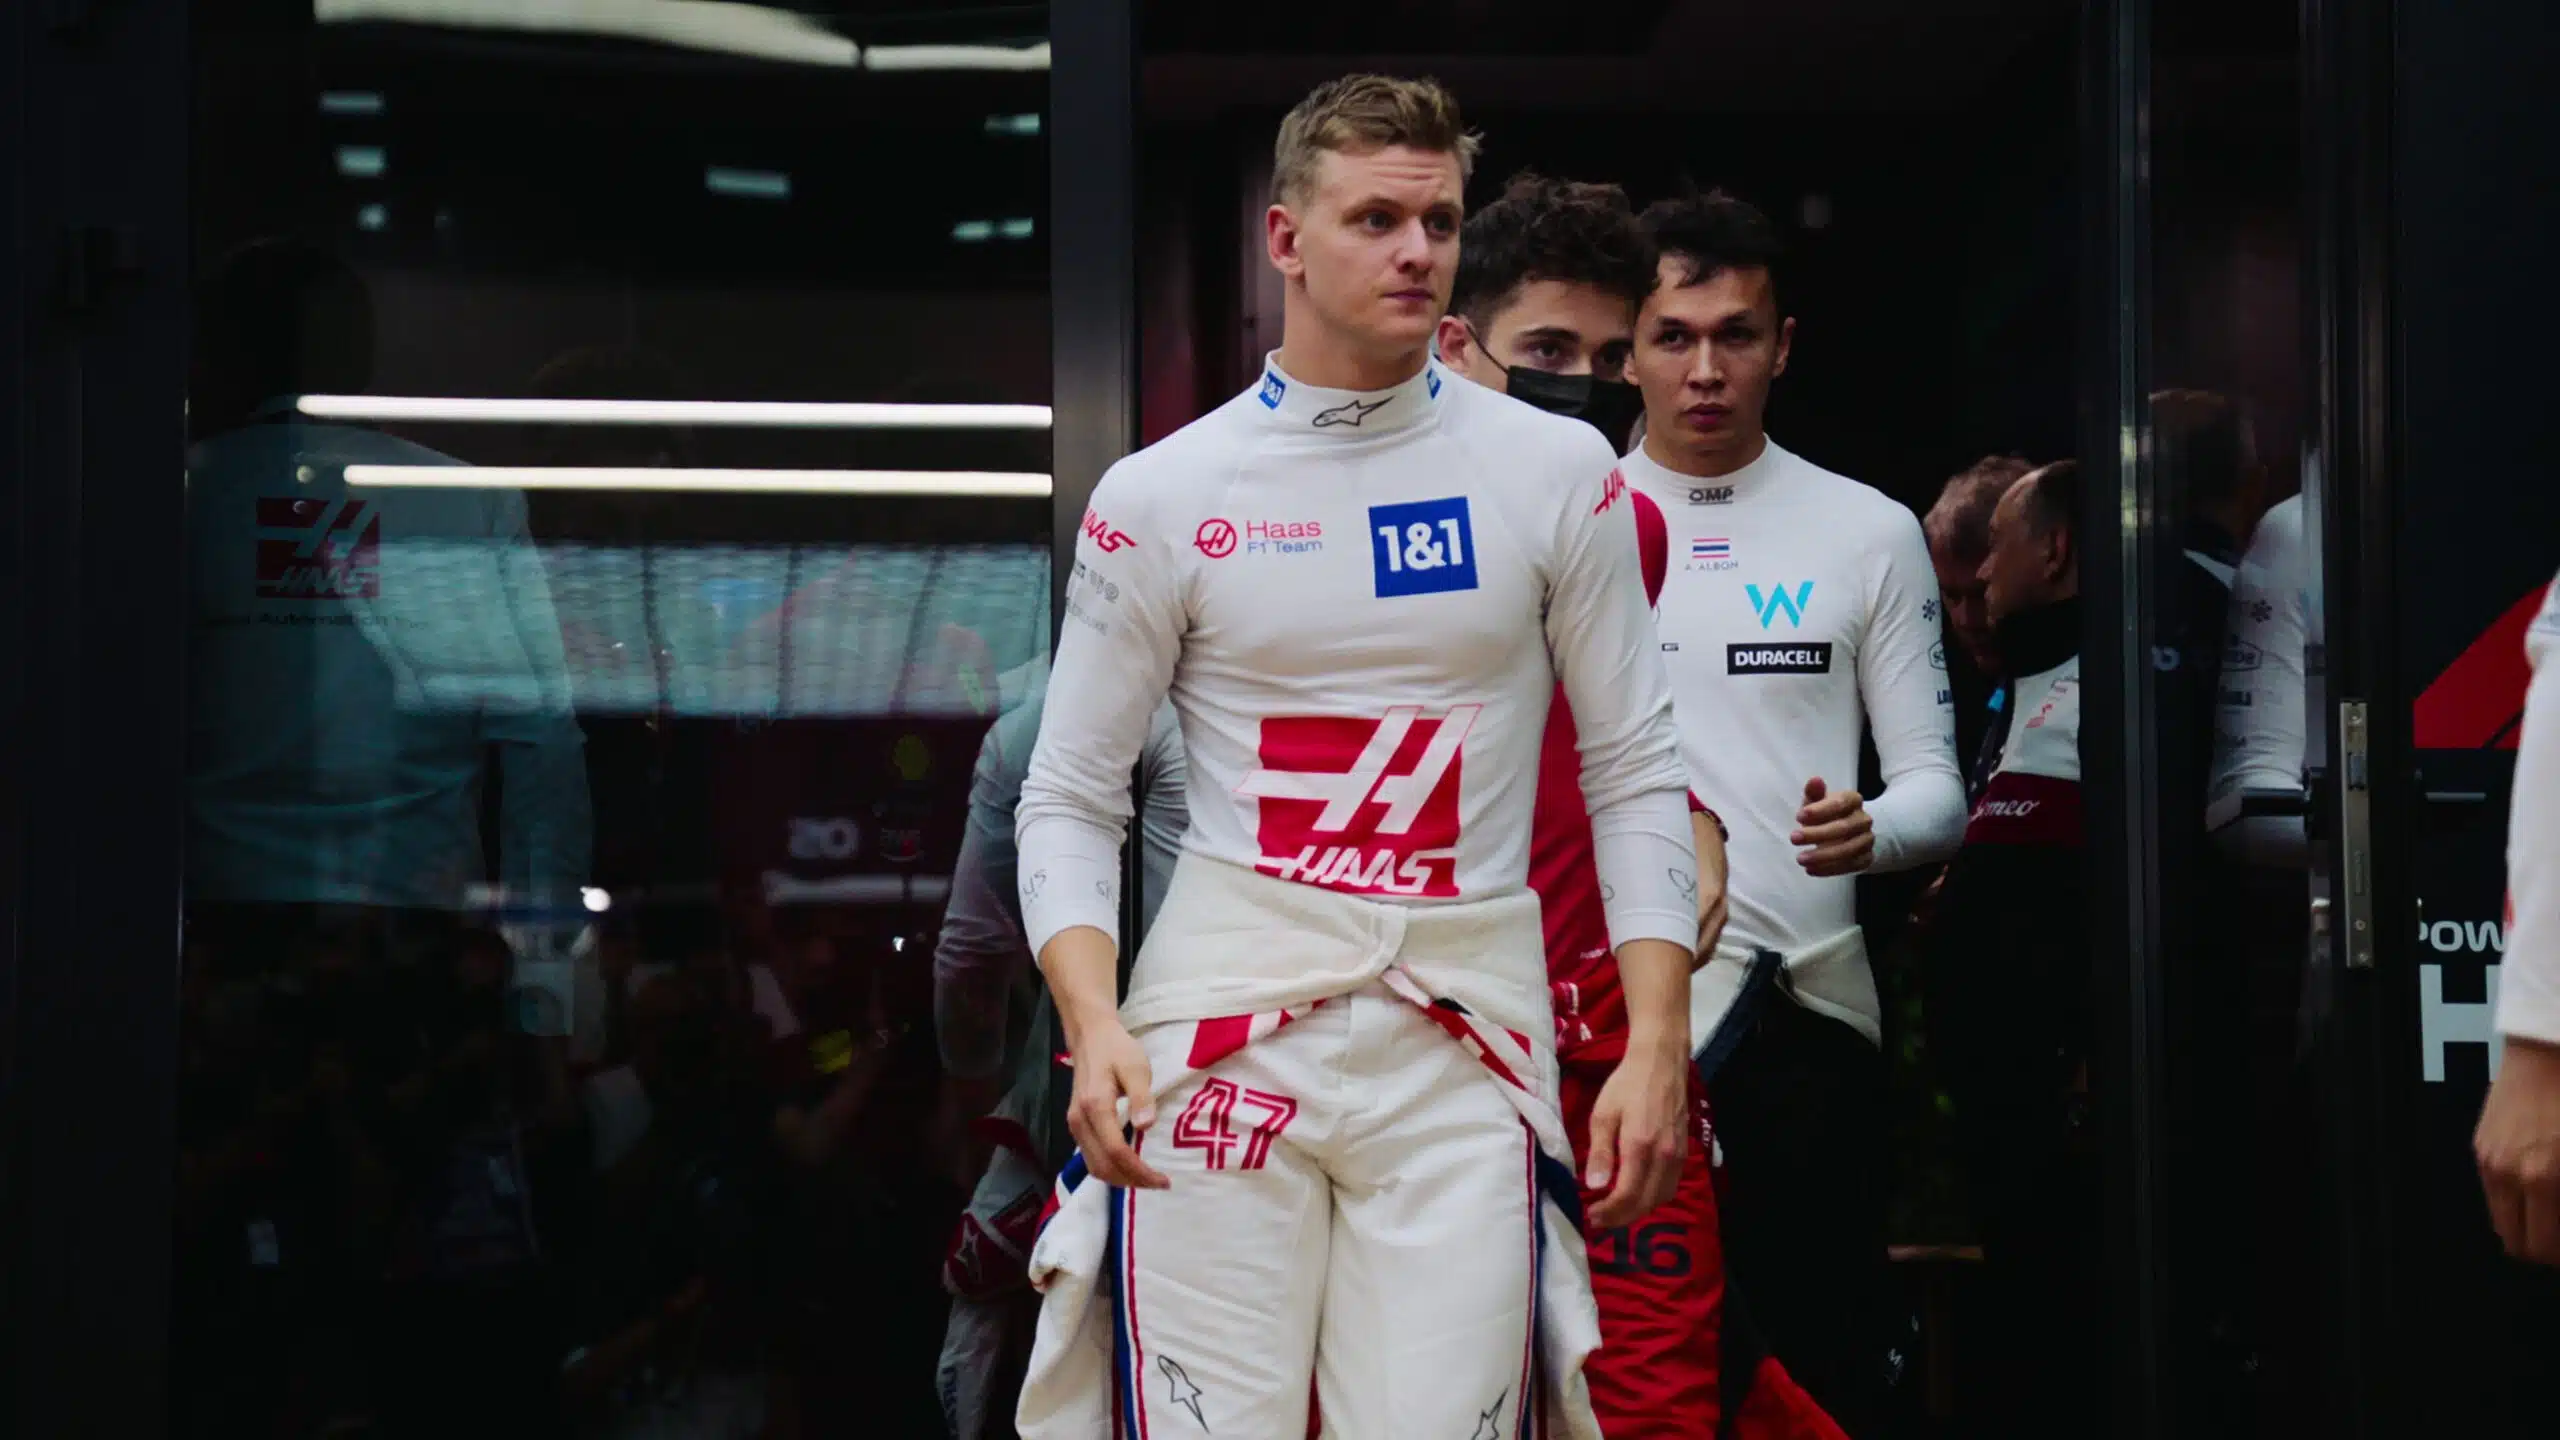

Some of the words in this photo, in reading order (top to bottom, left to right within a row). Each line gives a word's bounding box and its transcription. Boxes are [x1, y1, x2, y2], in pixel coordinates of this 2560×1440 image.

[1688, 485, 1735, 502] OMP
[1246, 519, 1322, 539] Haas
[1247, 541, 1267, 554] F1
[1272, 540, 1323, 553] Team
[1379, 518, 1463, 573] 1&1
[1697, 560, 1740, 571] ALBON
[1734, 650, 1825, 667] DURACELL
[1255, 845, 1460, 893] HAAS
[1172, 1077, 1297, 1171] 47
[1592, 1222, 1692, 1277] 16
